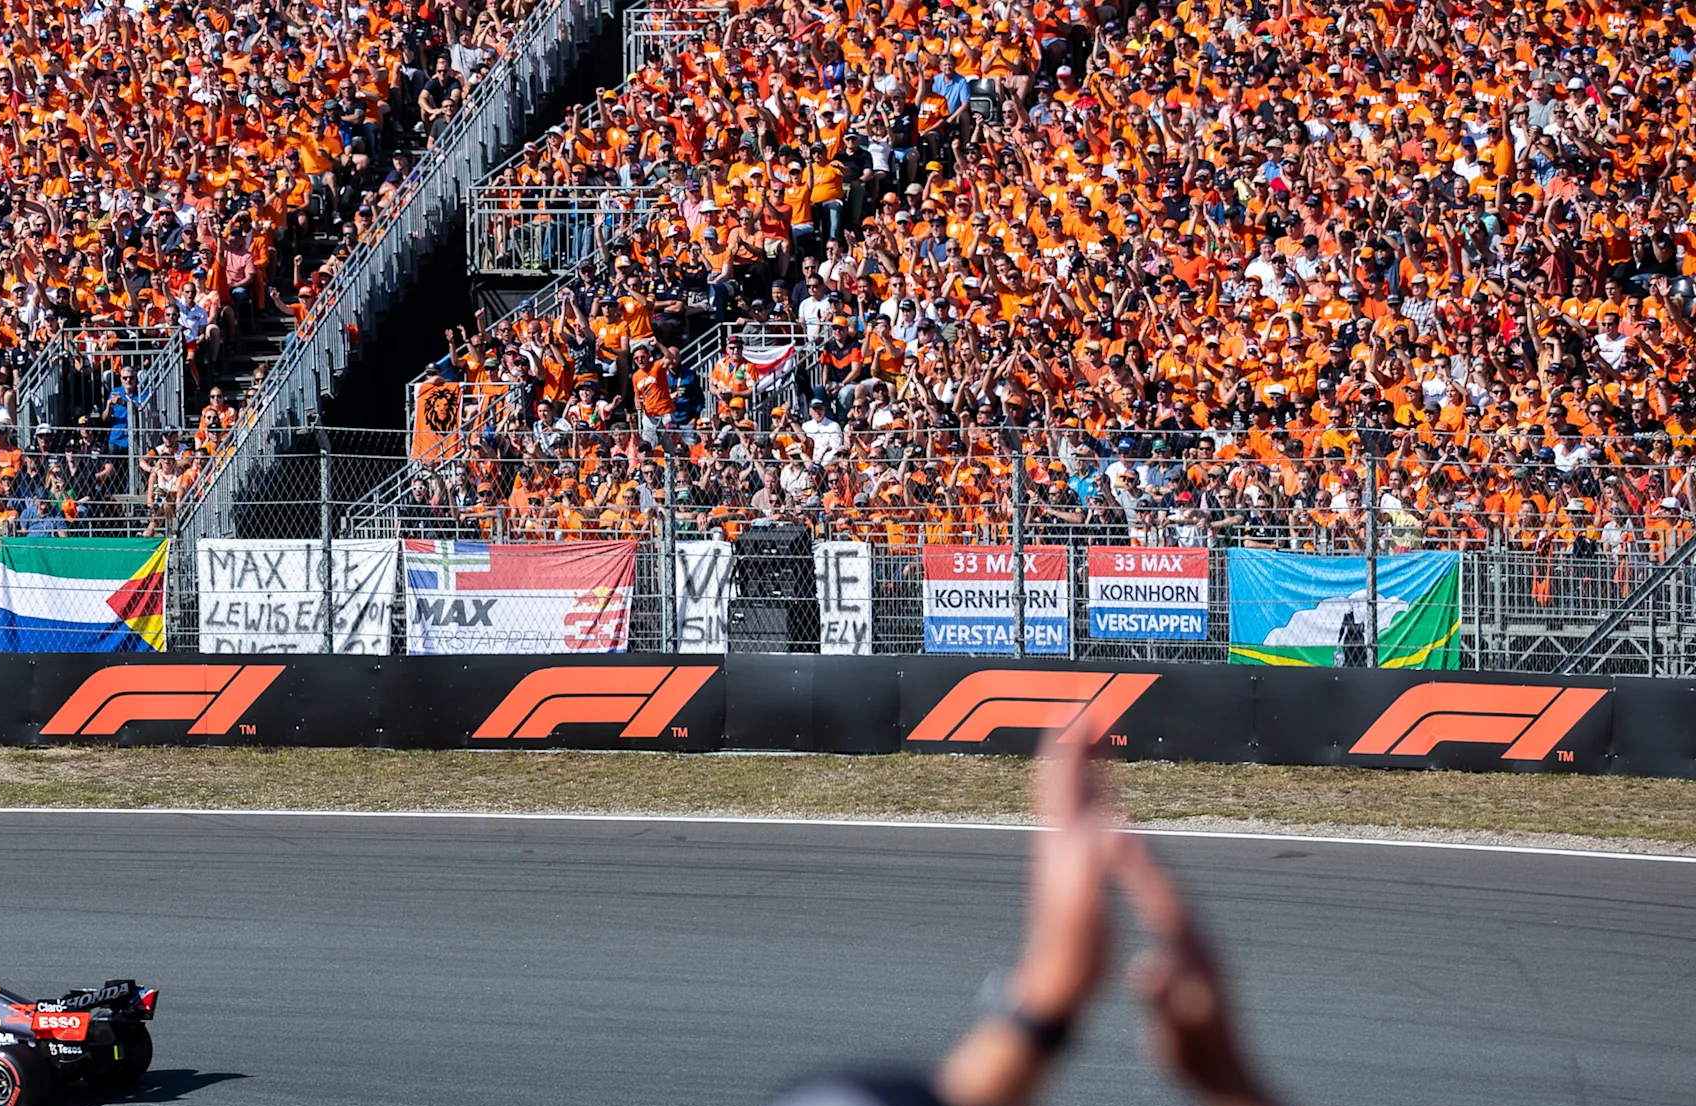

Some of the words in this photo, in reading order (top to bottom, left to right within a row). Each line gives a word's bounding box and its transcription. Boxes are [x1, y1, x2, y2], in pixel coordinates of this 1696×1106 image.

[208, 547, 287, 590] MAX
[952, 553, 978, 574] 33
[1114, 554, 1136, 572] 33
[1141, 554, 1183, 572] MAX
[1100, 584, 1199, 602] KORNHORN
[206, 595, 290, 634] LEWIS
[412, 598, 498, 626] MAX
[563, 609, 628, 650] 33
[1095, 613, 1202, 633] VERSTAPPEN
[412, 630, 552, 650] VERSTAPPEN
[930, 625, 1063, 646] VERSTAPEN
[239, 725, 257, 735] TM
[671, 727, 688, 737] TM
[1109, 735, 1128, 746] TM
[1556, 751, 1574, 762] TM
[65, 983, 129, 1009] HONDA
[37, 1001, 63, 1013] Claro
[39, 1016, 81, 1029] ESSO
